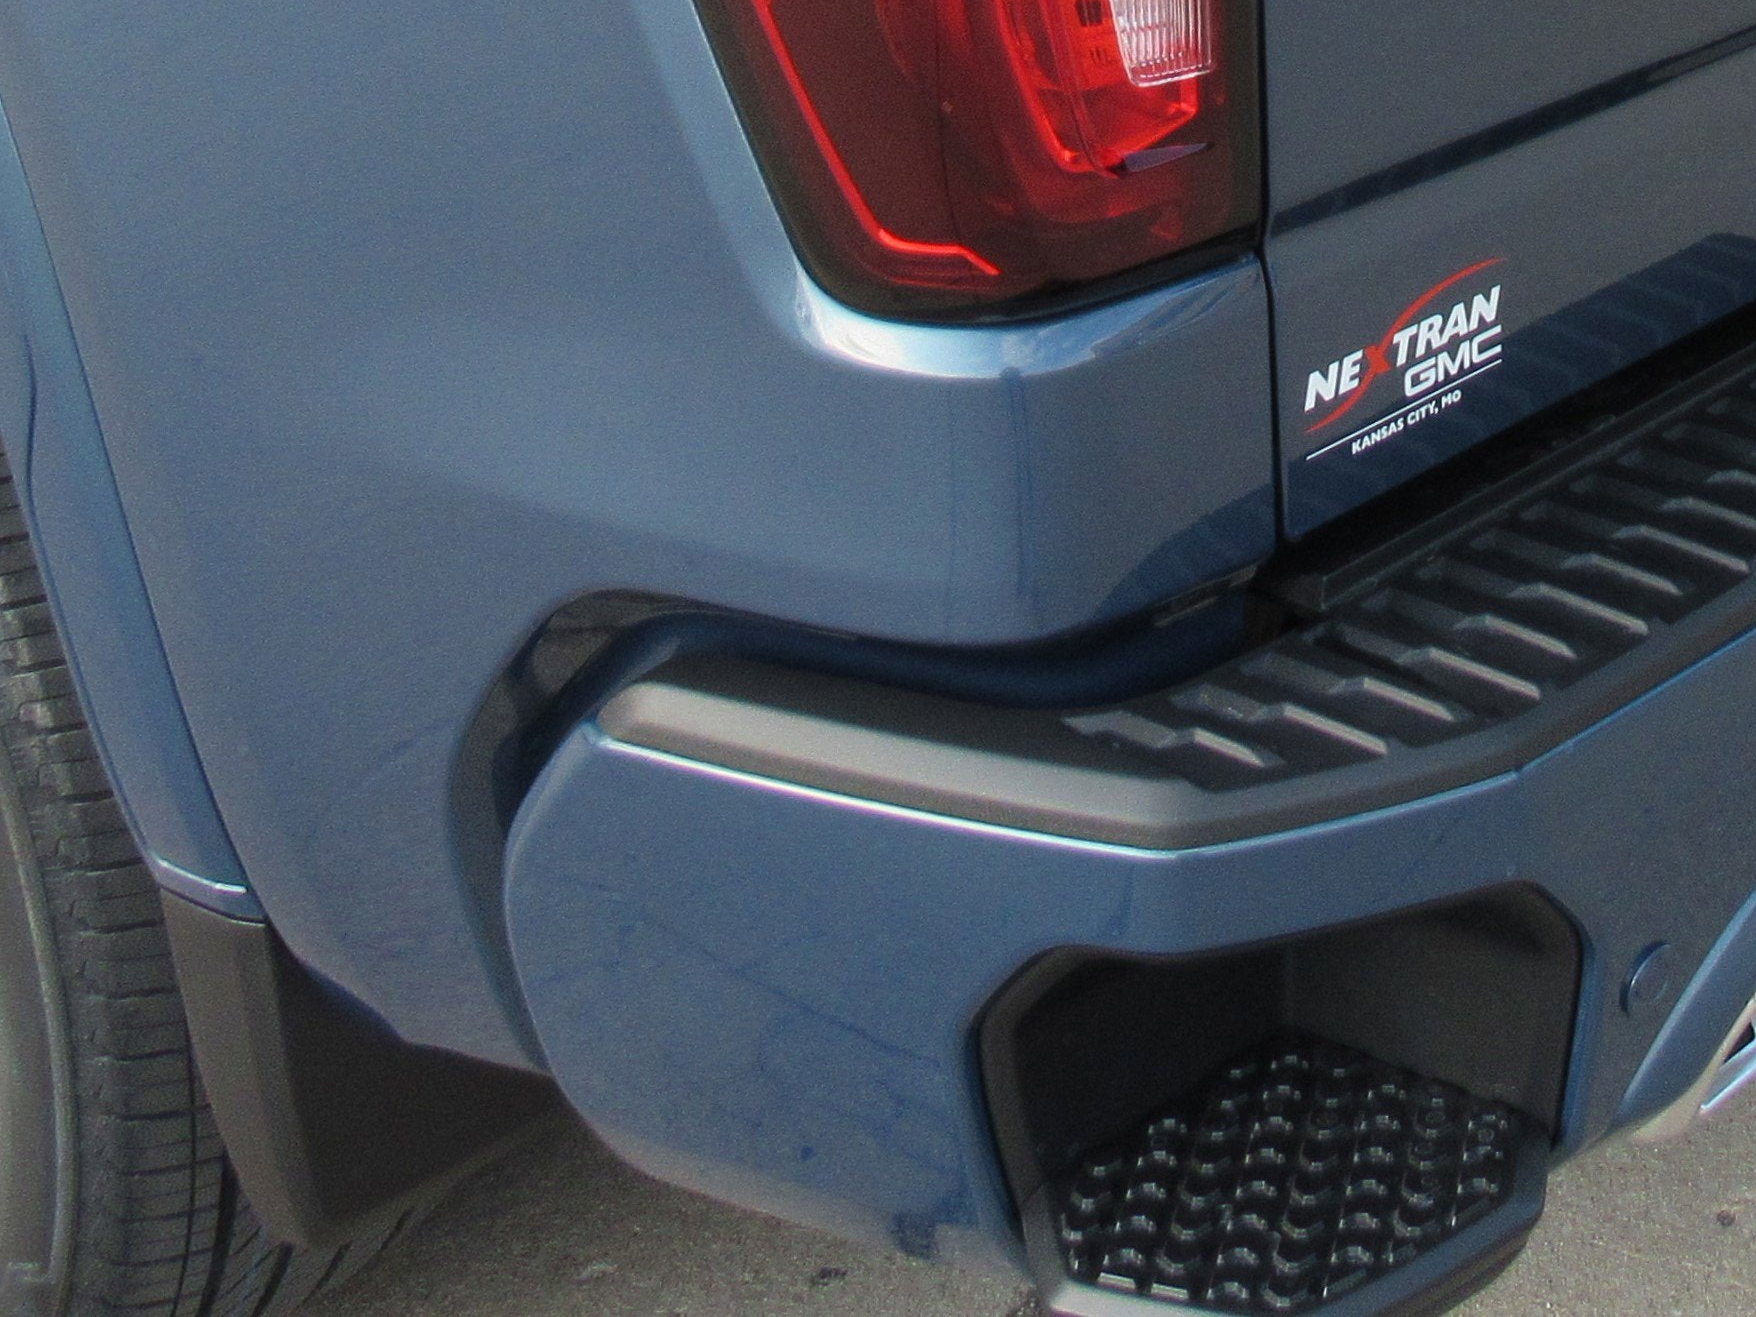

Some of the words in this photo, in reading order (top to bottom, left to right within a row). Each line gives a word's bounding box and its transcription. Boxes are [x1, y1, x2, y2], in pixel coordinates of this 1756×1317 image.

[1304, 284, 1501, 413] NEXTRAN
[1404, 323, 1502, 398] GMC
[1351, 418, 1404, 455] KANSAS
[1406, 401, 1439, 426] CITY,
[1441, 389, 1462, 409] MO
